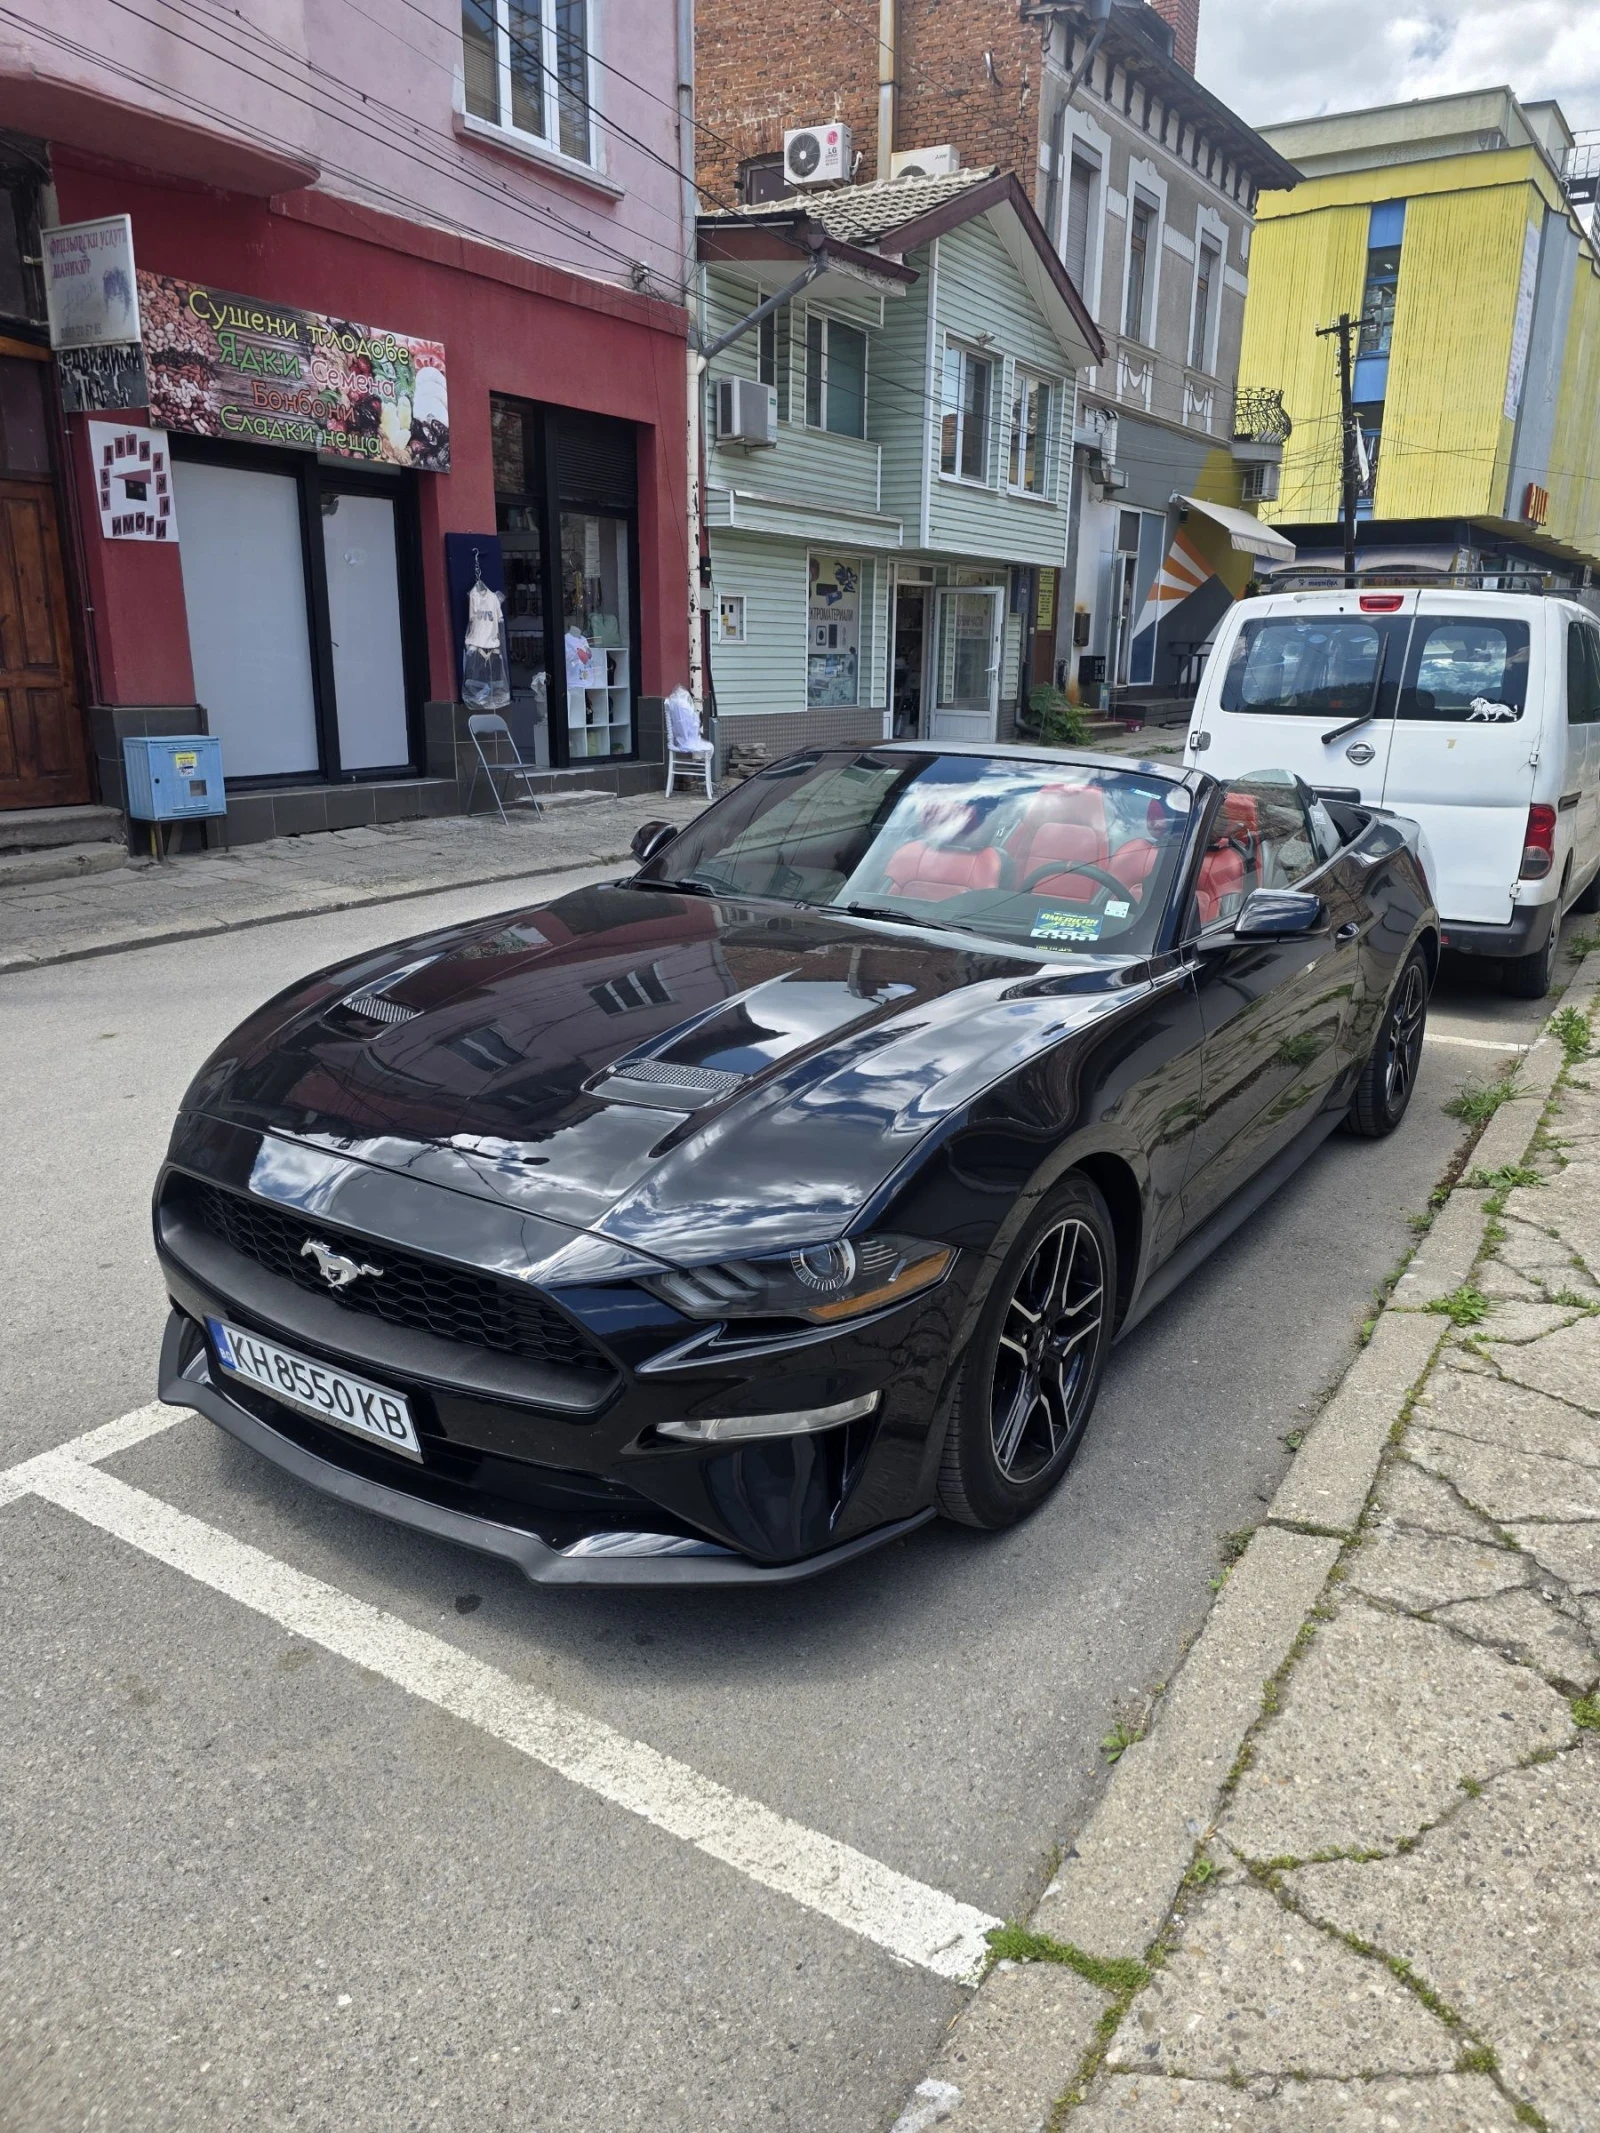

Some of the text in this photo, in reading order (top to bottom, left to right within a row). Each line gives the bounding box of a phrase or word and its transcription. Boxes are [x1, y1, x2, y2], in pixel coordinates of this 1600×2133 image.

[53, 259, 91, 278] МАНИКЮР
[188, 290, 410, 365] Сушени плодове
[216, 331, 396, 398] Ядки Семена
[251, 381, 356, 423] Бонбони
[220, 405, 382, 457] Сладки неща
[112, 513, 167, 540] ИМОТИ
[1041, 913, 1099, 927] AMERICAN
[219, 1347, 233, 1362] BG
